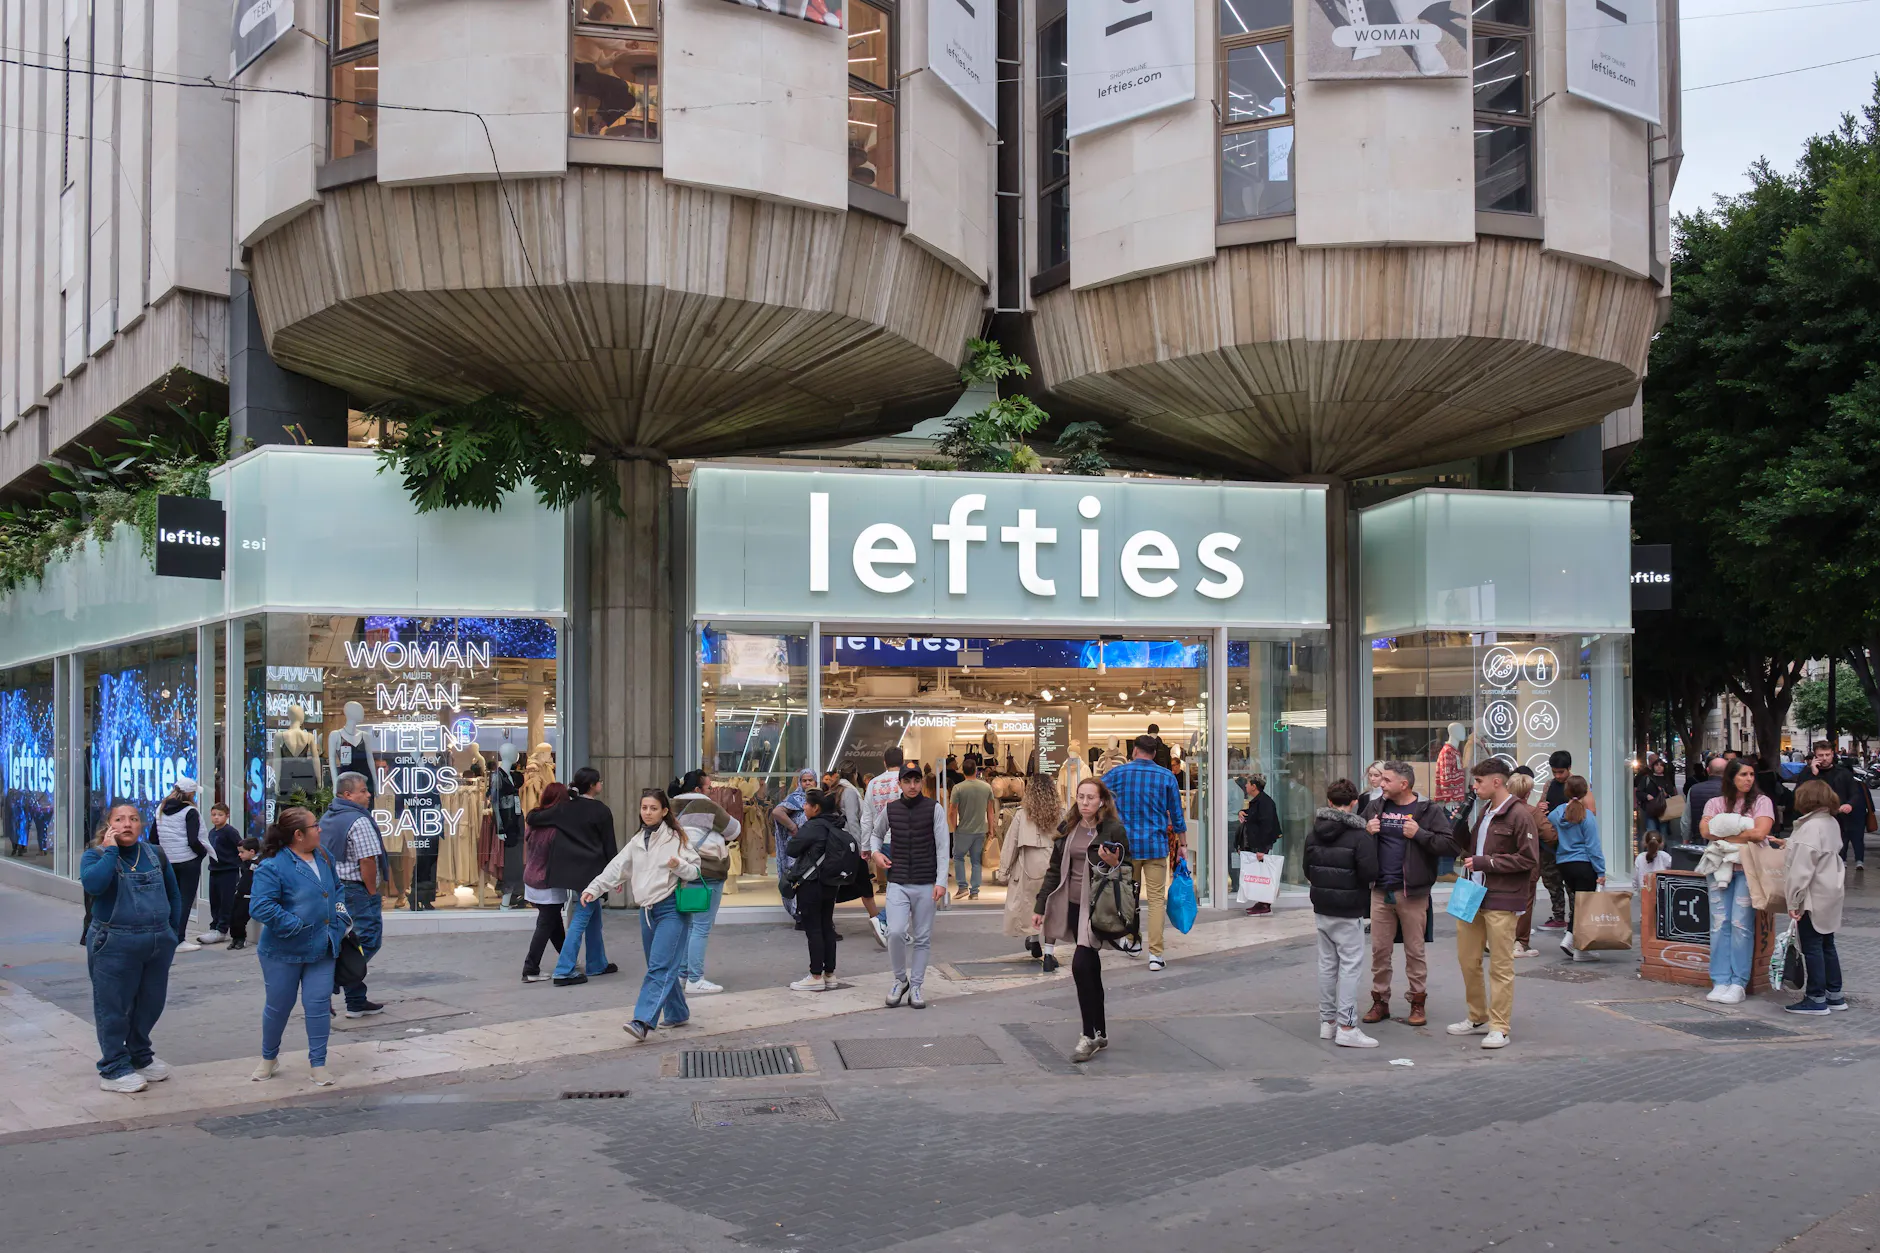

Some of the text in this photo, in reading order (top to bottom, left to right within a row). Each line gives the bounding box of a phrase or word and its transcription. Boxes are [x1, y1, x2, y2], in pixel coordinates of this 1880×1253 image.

[1354, 29, 1420, 41] WOMAN
[946, 43, 981, 84] lefties.com
[1109, 62, 1147, 80] SHOP ONLINE
[1591, 59, 1636, 87] lefties.com
[1098, 71, 1162, 98] lefties.com
[160, 528, 221, 547] lefties
[809, 492, 1244, 599] lefties
[344, 640, 490, 669] WOMAN
[402, 671, 432, 680] MUJER
[376, 682, 459, 711] MAN
[397, 713, 437, 722] HOMBRE
[910, 716, 957, 727] HOMBRE
[372, 724, 464, 752] TEEN
[1039, 727, 1047, 737] 3
[394, 756, 416, 764] GIRL
[421, 756, 441, 764] BOY
[1039, 746, 1047, 757] 2
[8, 738, 54, 793] lefties
[377, 766, 459, 795] KIDS
[403, 796, 433, 806] NIÑOS
[371, 808, 464, 837] BABY
[407, 839, 430, 848] BEBÉ
[1590, 912, 1620, 922] lefties
